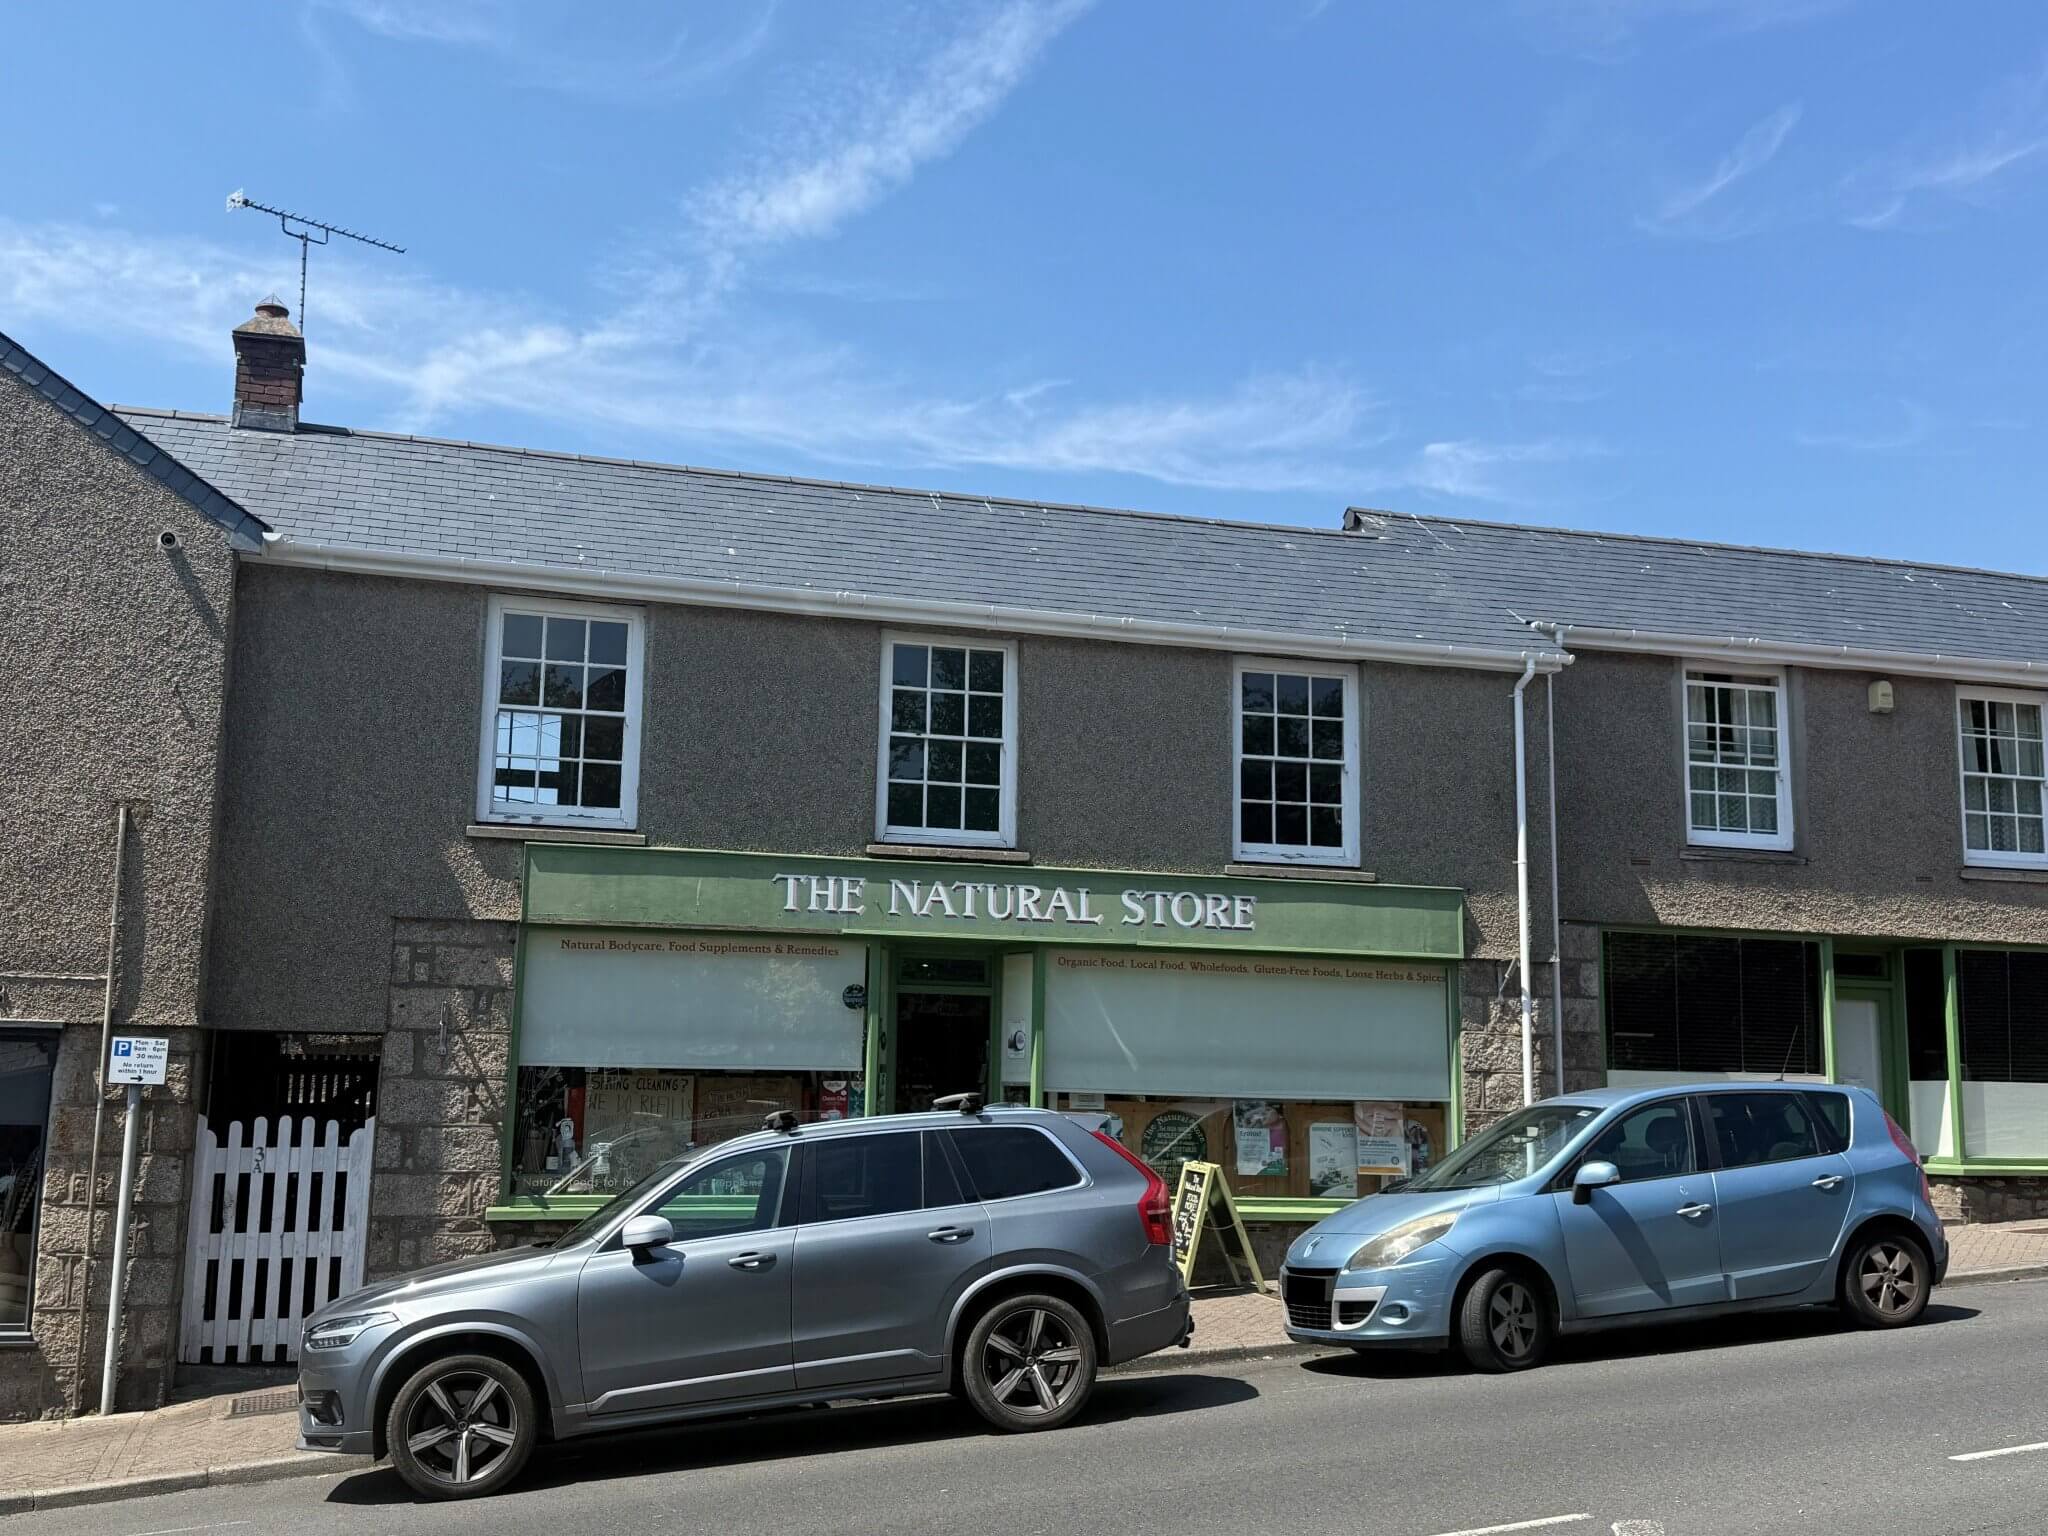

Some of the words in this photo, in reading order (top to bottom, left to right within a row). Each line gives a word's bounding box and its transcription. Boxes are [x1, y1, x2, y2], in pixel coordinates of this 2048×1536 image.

[772, 873, 866, 916] THE
[888, 879, 1104, 926] NATURAL
[1120, 889, 1258, 930] STORE
[560, 939, 605, 951] Natural
[669, 941, 696, 952] Food
[699, 942, 772, 955] Supplements
[775, 944, 784, 954] &
[787, 944, 840, 956] Remedies
[1057, 956, 1098, 969] Organic
[1130, 959, 1157, 970] Local
[1253, 963, 1311, 976] Gluten-Free
[1346, 968, 1373, 979] Loose
[1376, 970, 1404, 981] Herbs
[1406, 972, 1415, 982] &
[118, 1041, 130, 1056] P
[636, 1078, 689, 1093] CLEANING?
[254, 1146, 265, 1162] 3
[252, 1161, 262, 1174] A
